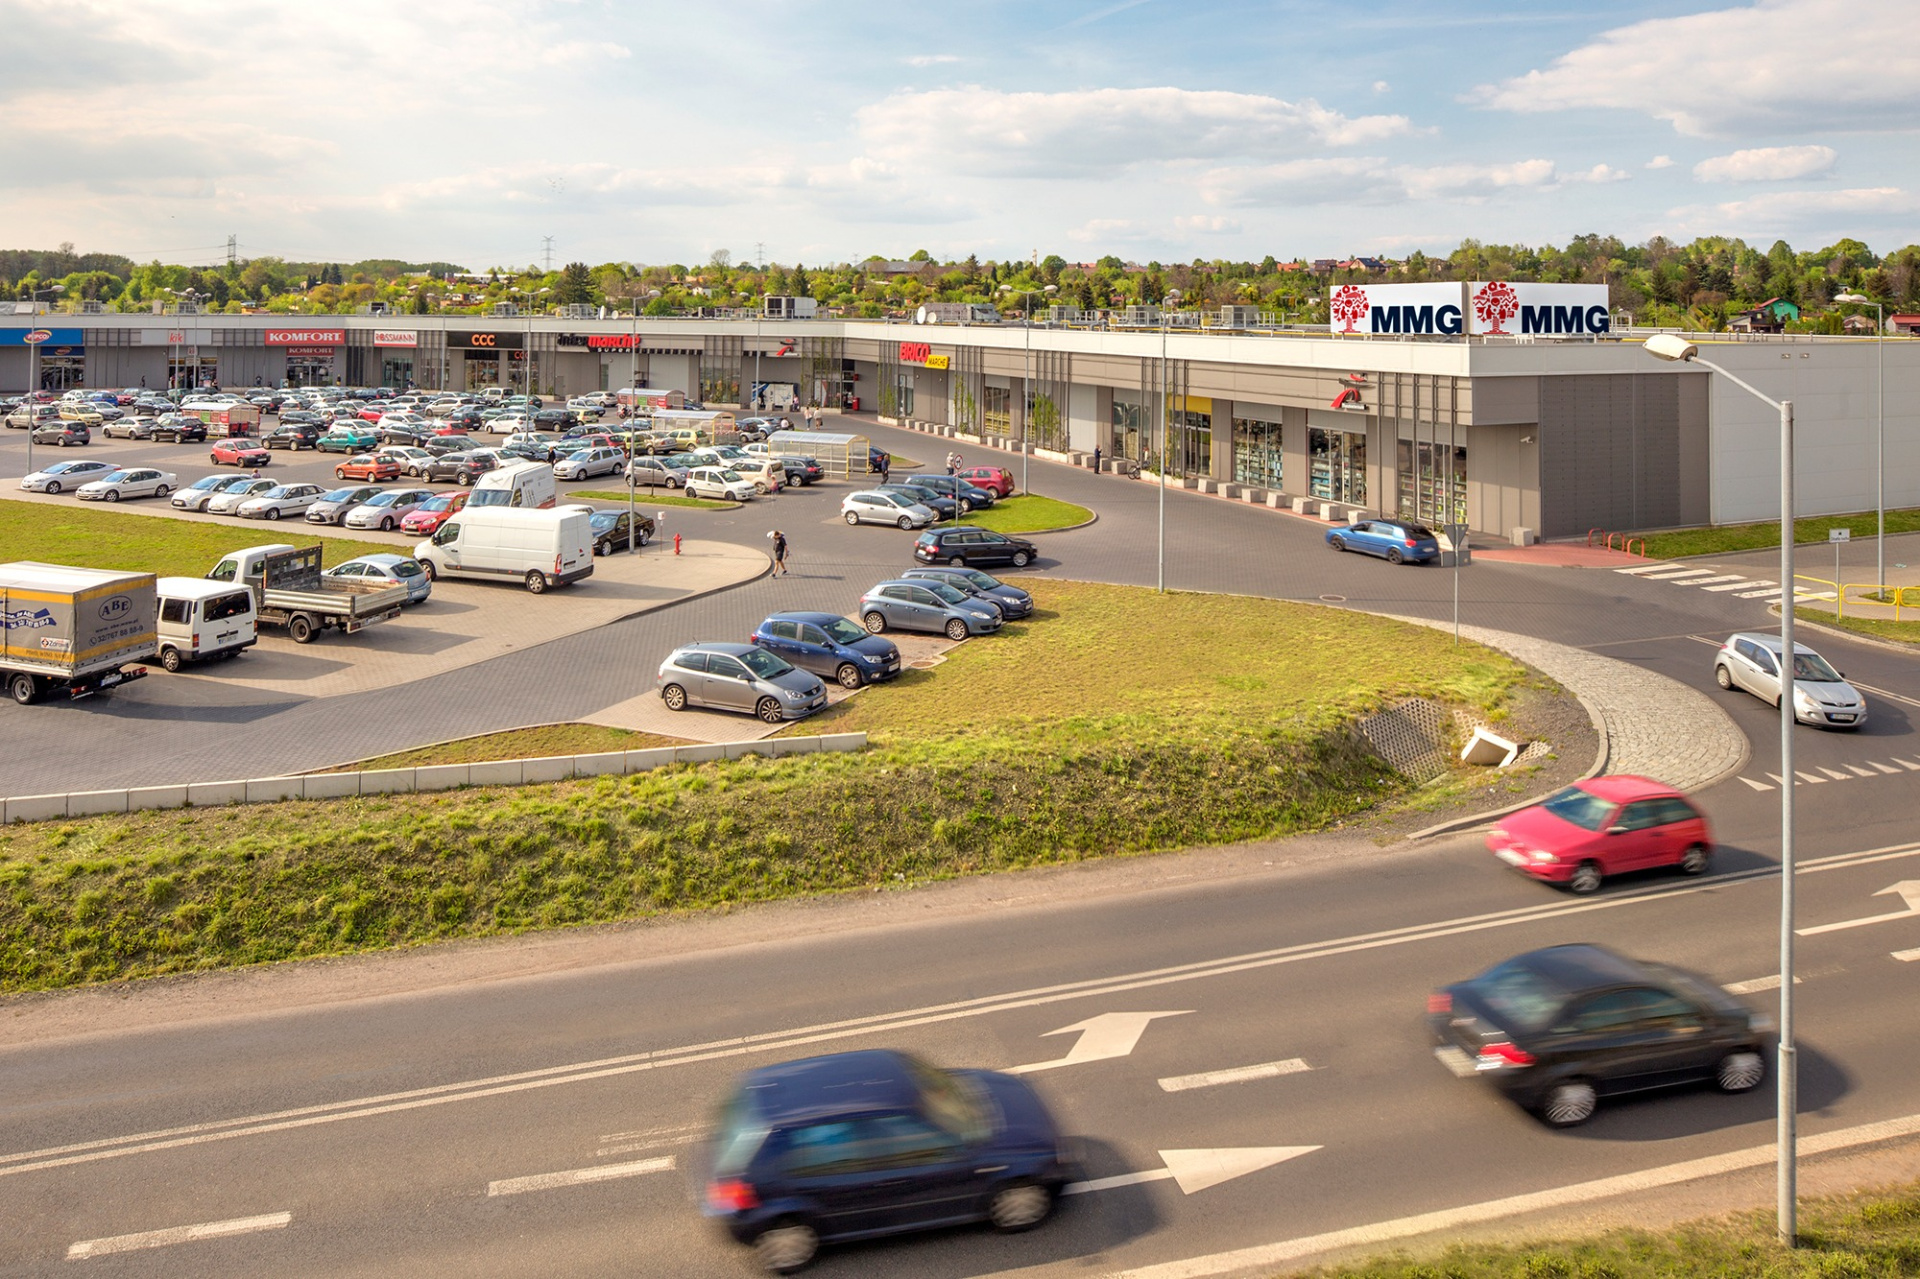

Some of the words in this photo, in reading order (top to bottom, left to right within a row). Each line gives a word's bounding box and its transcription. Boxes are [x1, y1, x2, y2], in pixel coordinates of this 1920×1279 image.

[1371, 304, 1462, 334] MMG
[1521, 304, 1609, 334] MMG
[269, 332, 341, 342] KOMFORT
[375, 333, 415, 342] ROSSMANN
[471, 334, 495, 346] CCC
[900, 342, 930, 362] BRICO
[102, 601, 129, 616] ABE
